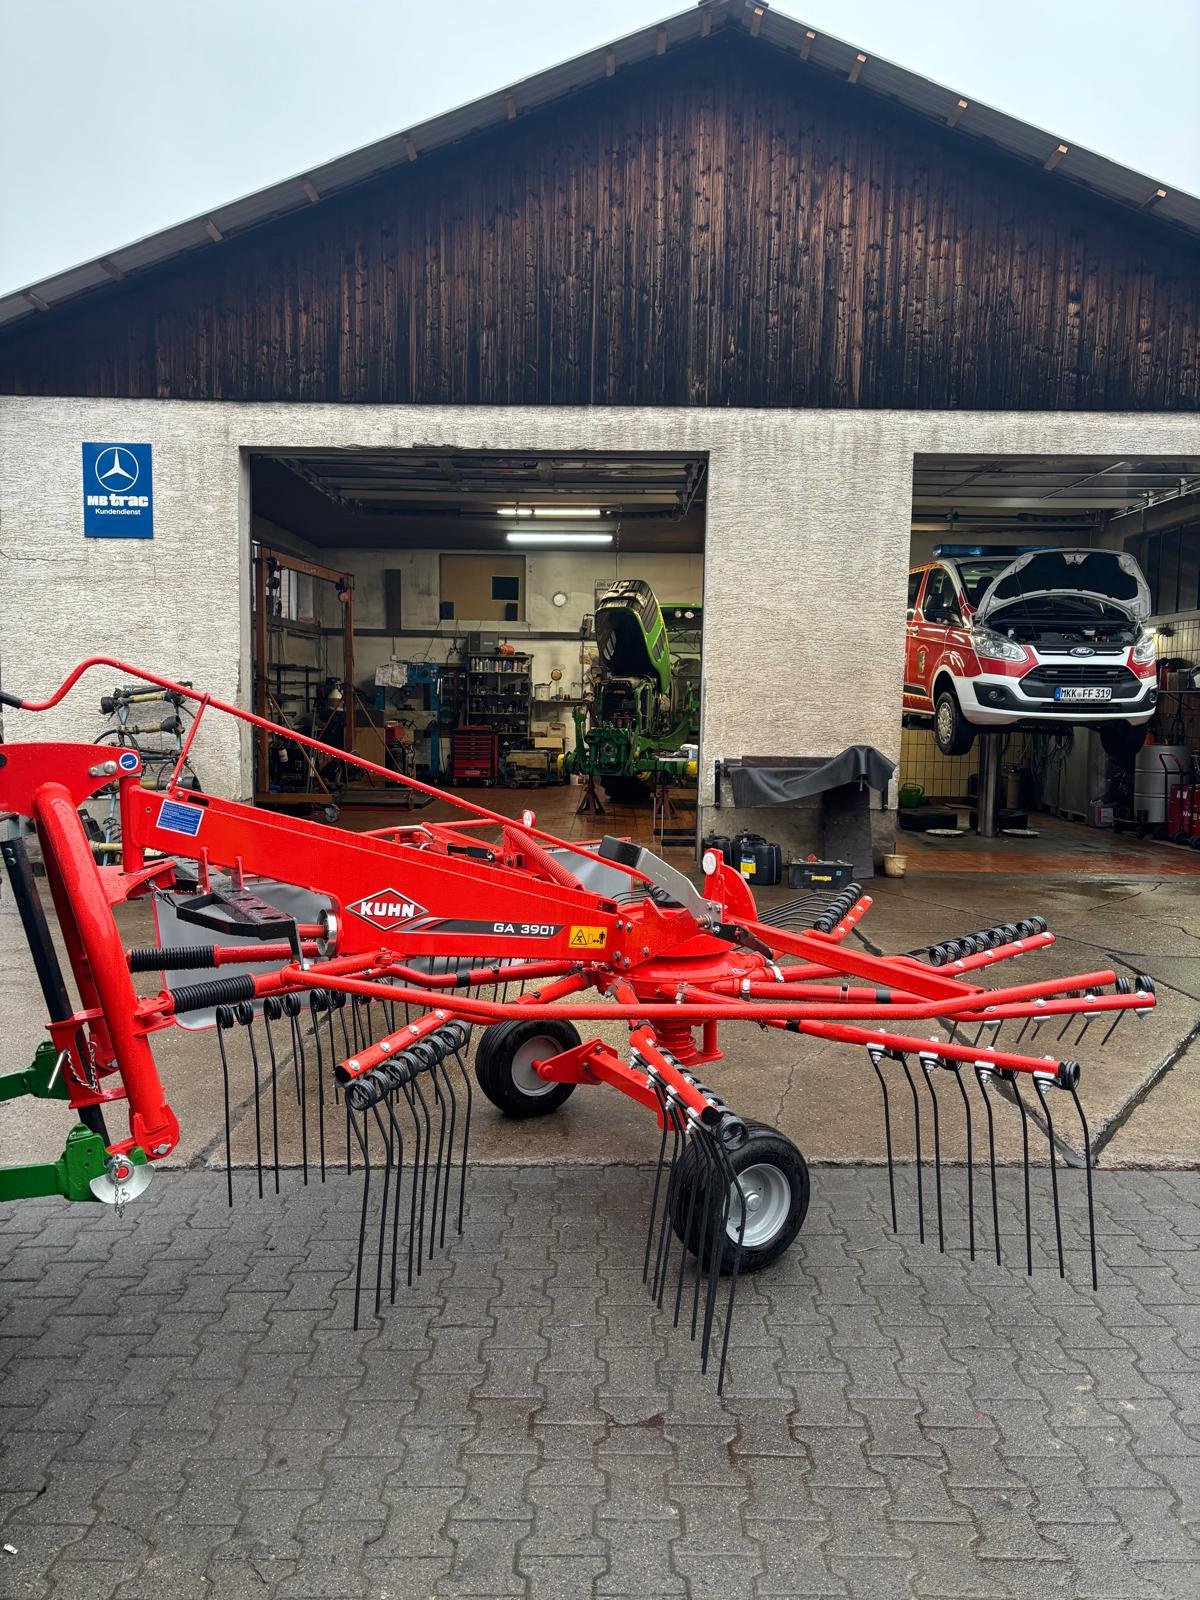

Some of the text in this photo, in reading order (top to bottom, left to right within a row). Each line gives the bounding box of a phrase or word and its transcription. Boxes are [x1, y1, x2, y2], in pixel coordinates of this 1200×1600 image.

[87, 493, 149, 507] MB trac
[95, 508, 141, 516] Kundendienst
[360, 901, 415, 917] KUHN
[493, 922, 555, 935] GA 3901
